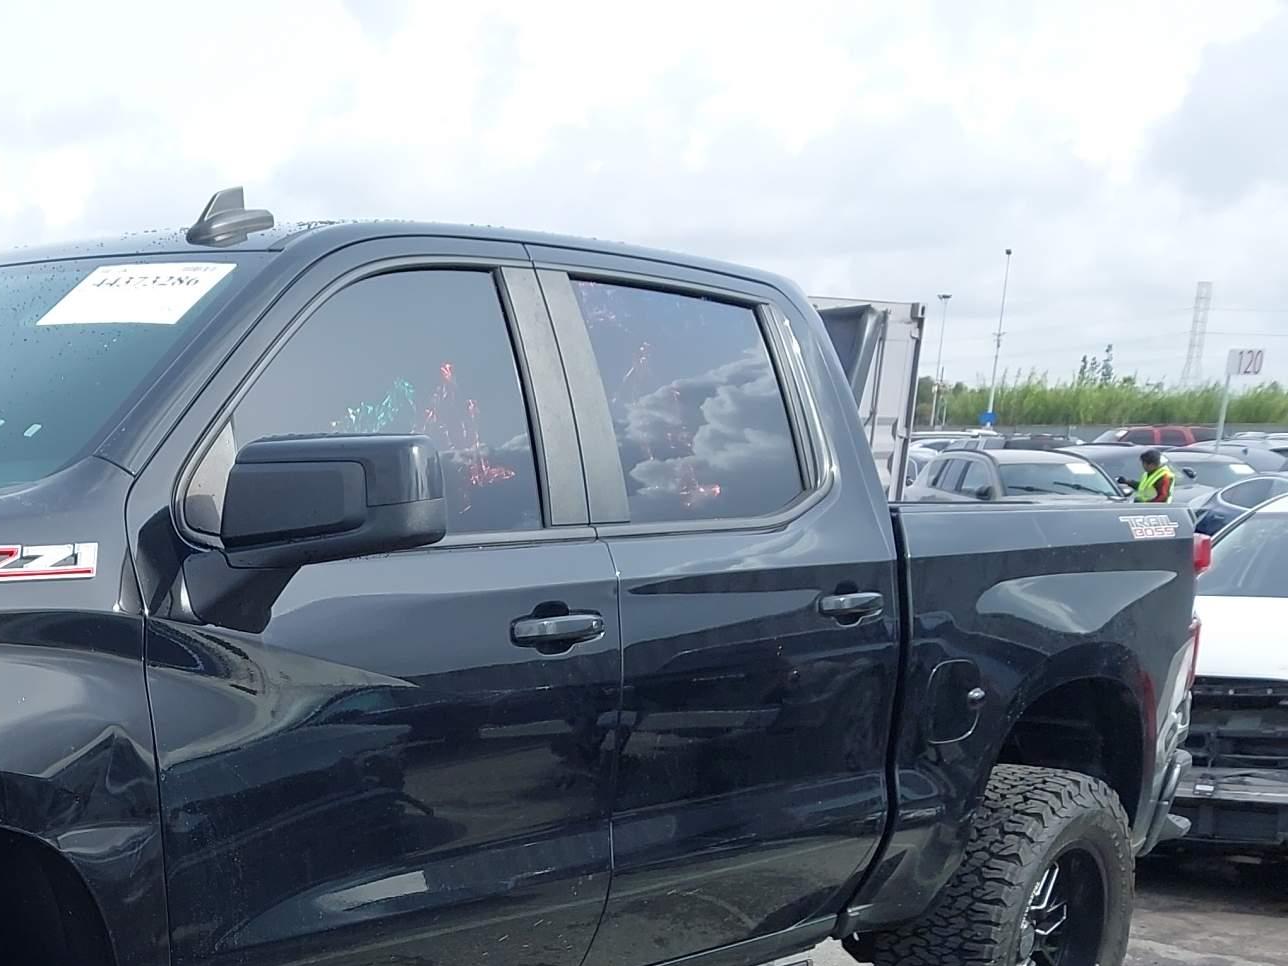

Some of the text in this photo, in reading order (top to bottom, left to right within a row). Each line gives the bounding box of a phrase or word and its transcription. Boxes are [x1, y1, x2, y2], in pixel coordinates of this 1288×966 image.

[1238, 349, 1264, 375] 120
[1118, 515, 1179, 528] TRAIL
[1132, 527, 1176, 539] BOSS
